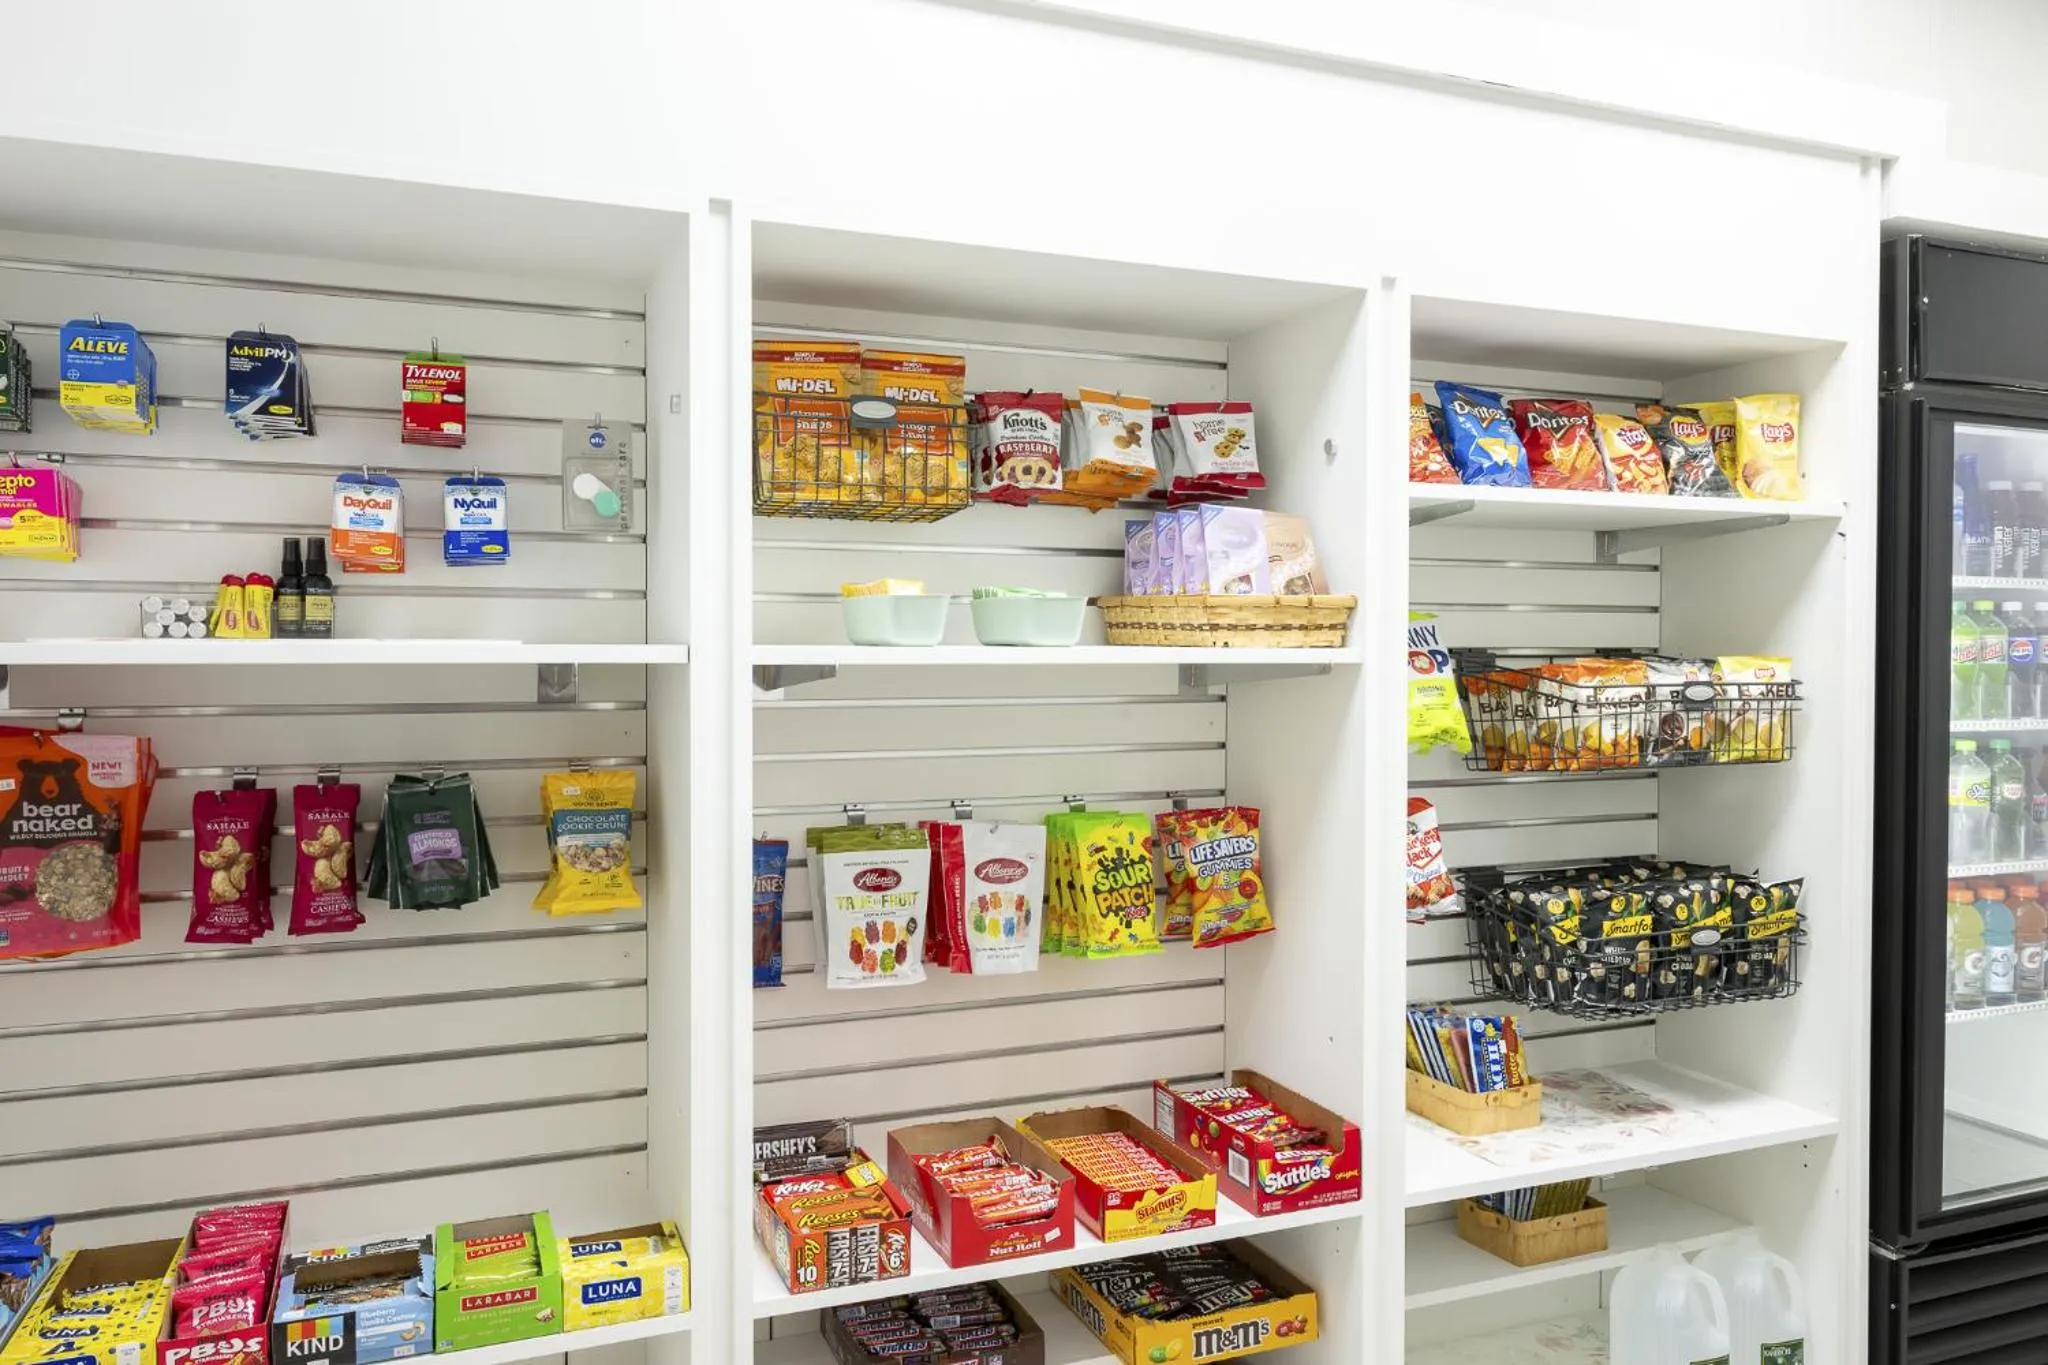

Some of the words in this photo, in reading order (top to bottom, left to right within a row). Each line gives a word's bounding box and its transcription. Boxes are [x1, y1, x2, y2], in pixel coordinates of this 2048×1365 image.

[67, 336, 129, 354] ALEVE
[230, 344, 263, 357] Advil
[405, 365, 461, 380] TYLENOL
[776, 377, 837, 393] MI-DEL
[1453, 400, 1507, 421] Doritos
[1003, 412, 1048, 431] Knott's
[1192, 417, 1225, 429] home
[1527, 412, 1589, 428] Doritos
[1201, 426, 1226, 437] free
[998, 443, 1055, 454] RASPBERRY
[343, 496, 393, 511] DayQuil
[453, 498, 497, 511] NyQuil
[22, 801, 82, 817] bear
[12, 814, 94, 833] naked
[566, 814, 627, 823] CHOCOLATE
[1199, 858, 1253, 877] GUMMIES
[1095, 863, 1150, 892] SOUR
[1095, 884, 1154, 915] PATCH
[1264, 1163, 1331, 1194] Skittles
[470, 1241, 523, 1257] LARABAR
[990, 1246, 1014, 1255] Nut
[890, 1253, 901, 1268] 6
[797, 1265, 817, 1284] 10
[588, 1281, 637, 1299] LUNA
[466, 1290, 532, 1307] LARABAR
[287, 1334, 344, 1357] KIND
